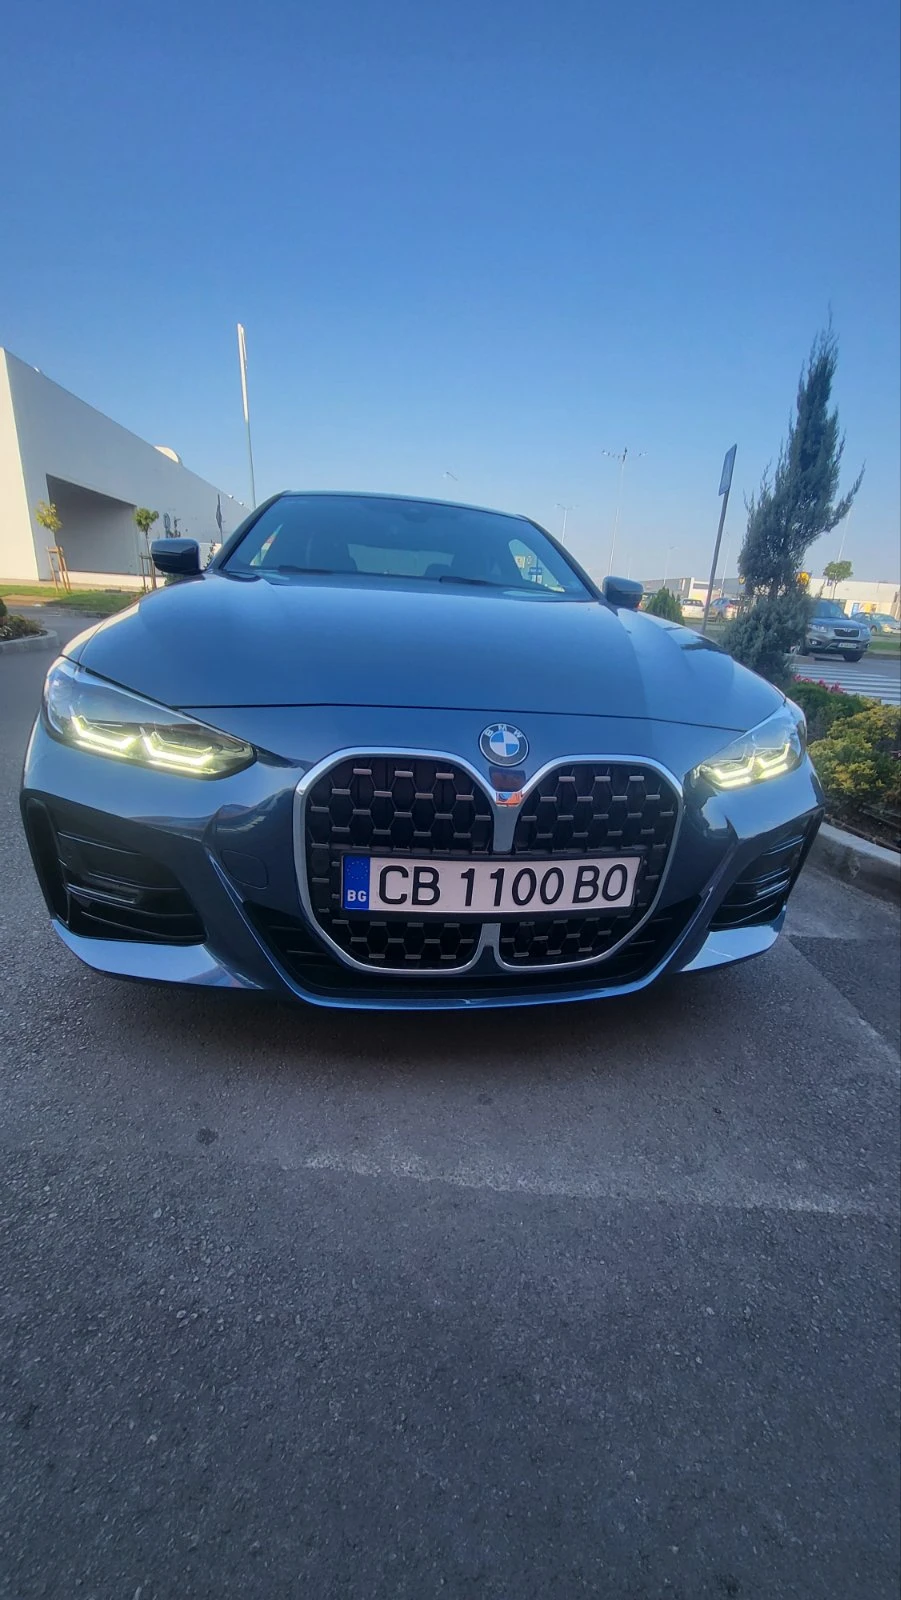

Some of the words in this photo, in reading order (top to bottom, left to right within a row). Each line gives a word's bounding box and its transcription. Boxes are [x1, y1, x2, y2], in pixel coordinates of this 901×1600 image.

[484, 724, 523, 738] BMW
[379, 865, 441, 906] CB
[460, 867, 565, 907] 1100
[347, 889, 367, 902] BG
